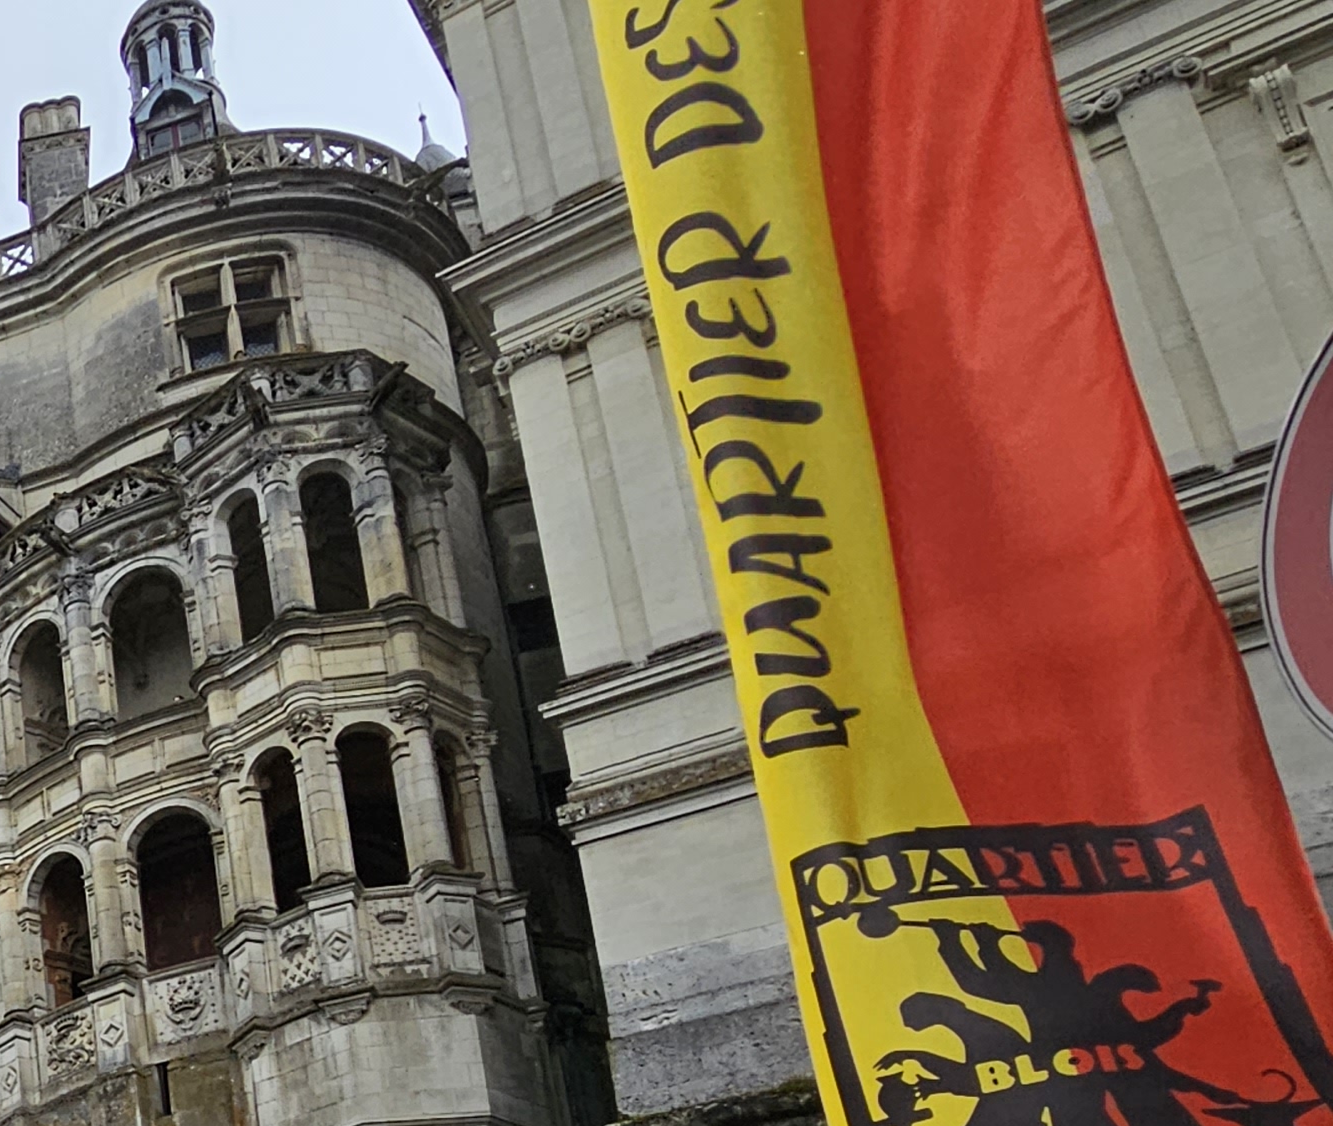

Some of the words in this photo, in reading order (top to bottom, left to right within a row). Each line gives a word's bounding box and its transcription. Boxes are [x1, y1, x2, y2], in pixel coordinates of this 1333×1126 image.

[658, 211, 860, 759] QUARTIER
[807, 826, 1208, 910] QUARTIER
[975, 1044, 1145, 1094] BLOIS
